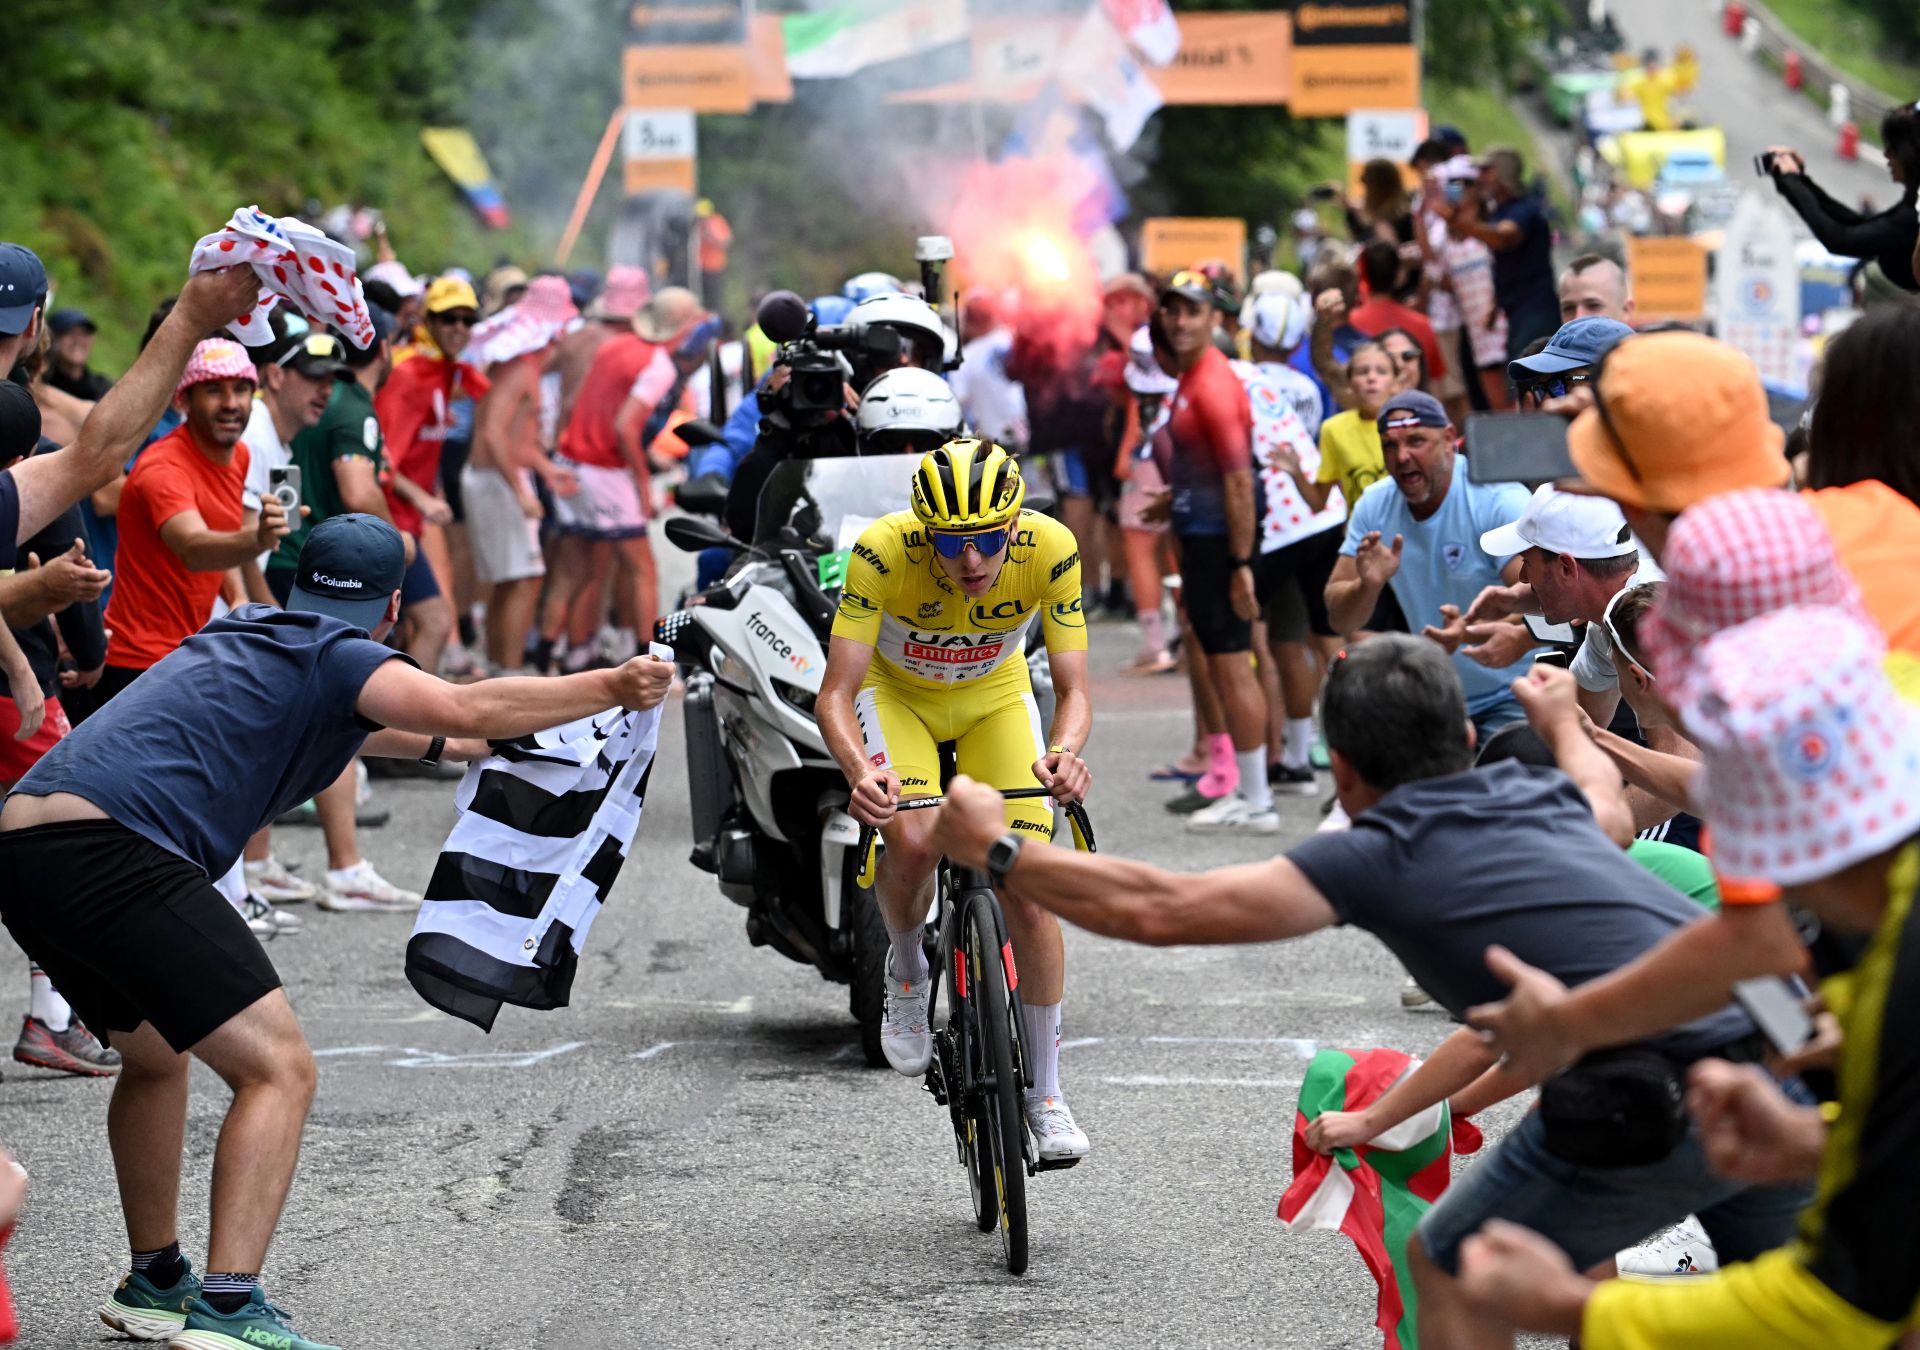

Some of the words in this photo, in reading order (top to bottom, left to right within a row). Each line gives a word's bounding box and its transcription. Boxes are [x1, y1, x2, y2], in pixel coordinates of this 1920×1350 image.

[320, 575, 362, 589] Columbia
[976, 599, 1032, 620] LCL
[1057, 598, 1081, 614] LC
[908, 631, 1006, 648] UAE
[908, 644, 998, 662] Emirates
[900, 777, 928, 787] ntini
[1010, 819, 1051, 837] Santin
[241, 1325, 292, 1350] HOKA
